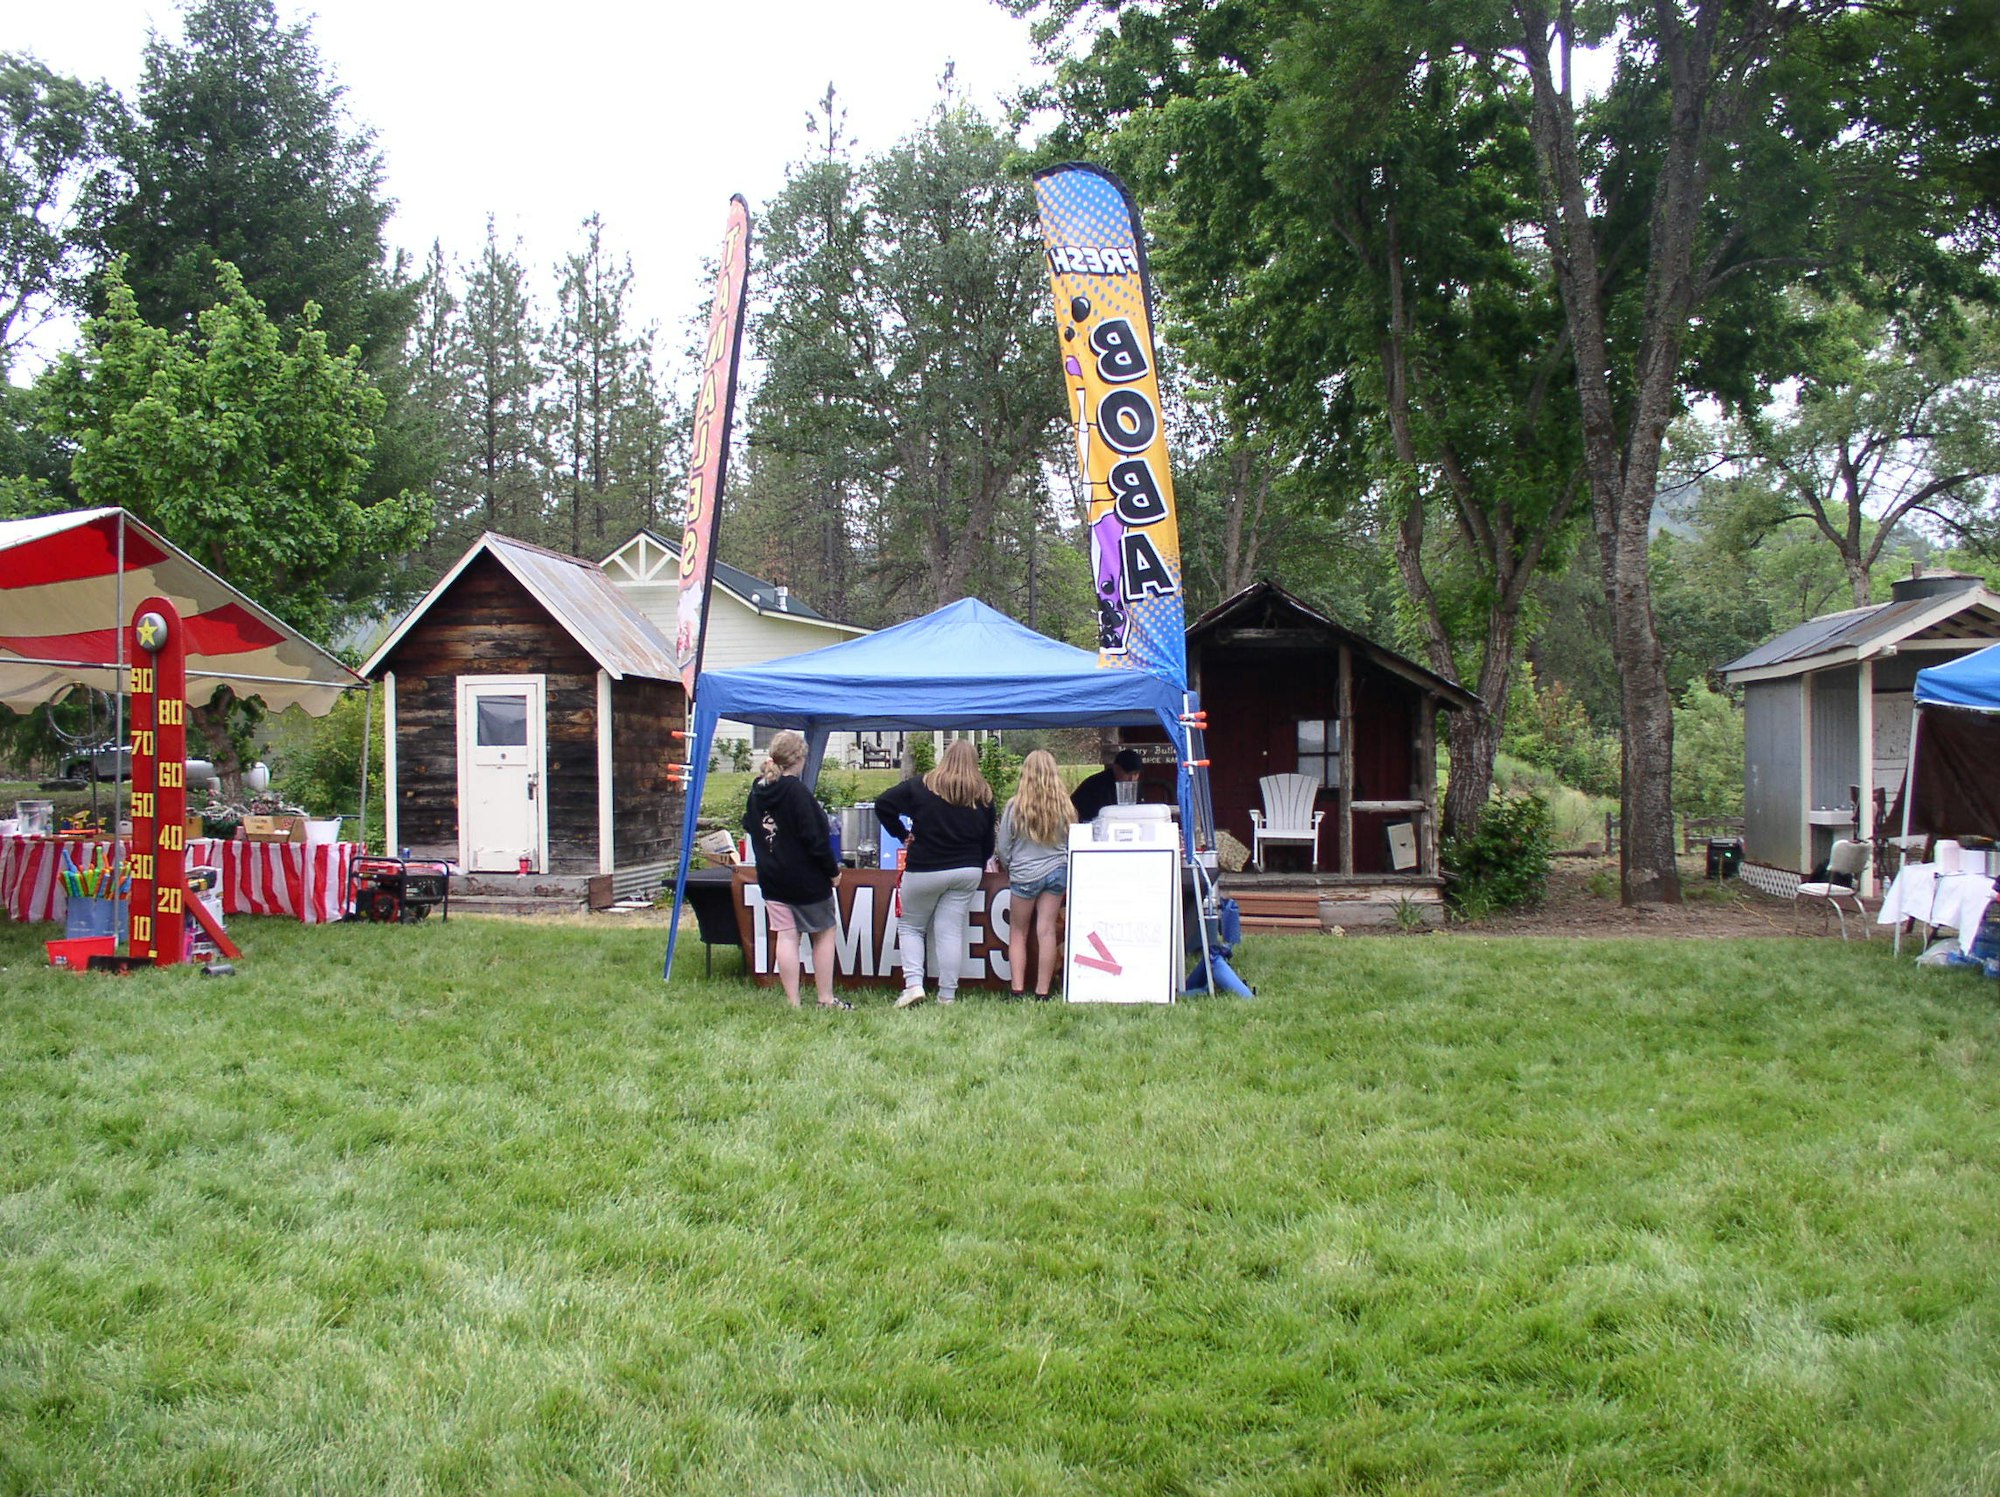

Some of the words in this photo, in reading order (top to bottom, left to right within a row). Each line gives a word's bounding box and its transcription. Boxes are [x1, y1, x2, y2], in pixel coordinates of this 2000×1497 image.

[131, 668, 153, 693] 90
[158, 699, 183, 725] 80
[131, 730, 154, 756] 70
[158, 762, 183, 788] 60
[131, 792, 154, 817] 50
[158, 824, 183, 851] 40
[130, 853, 154, 880] 30
[157, 887, 182, 914] 20
[133, 915, 151, 941] 10
[743, 884, 1012, 981] TMAES
